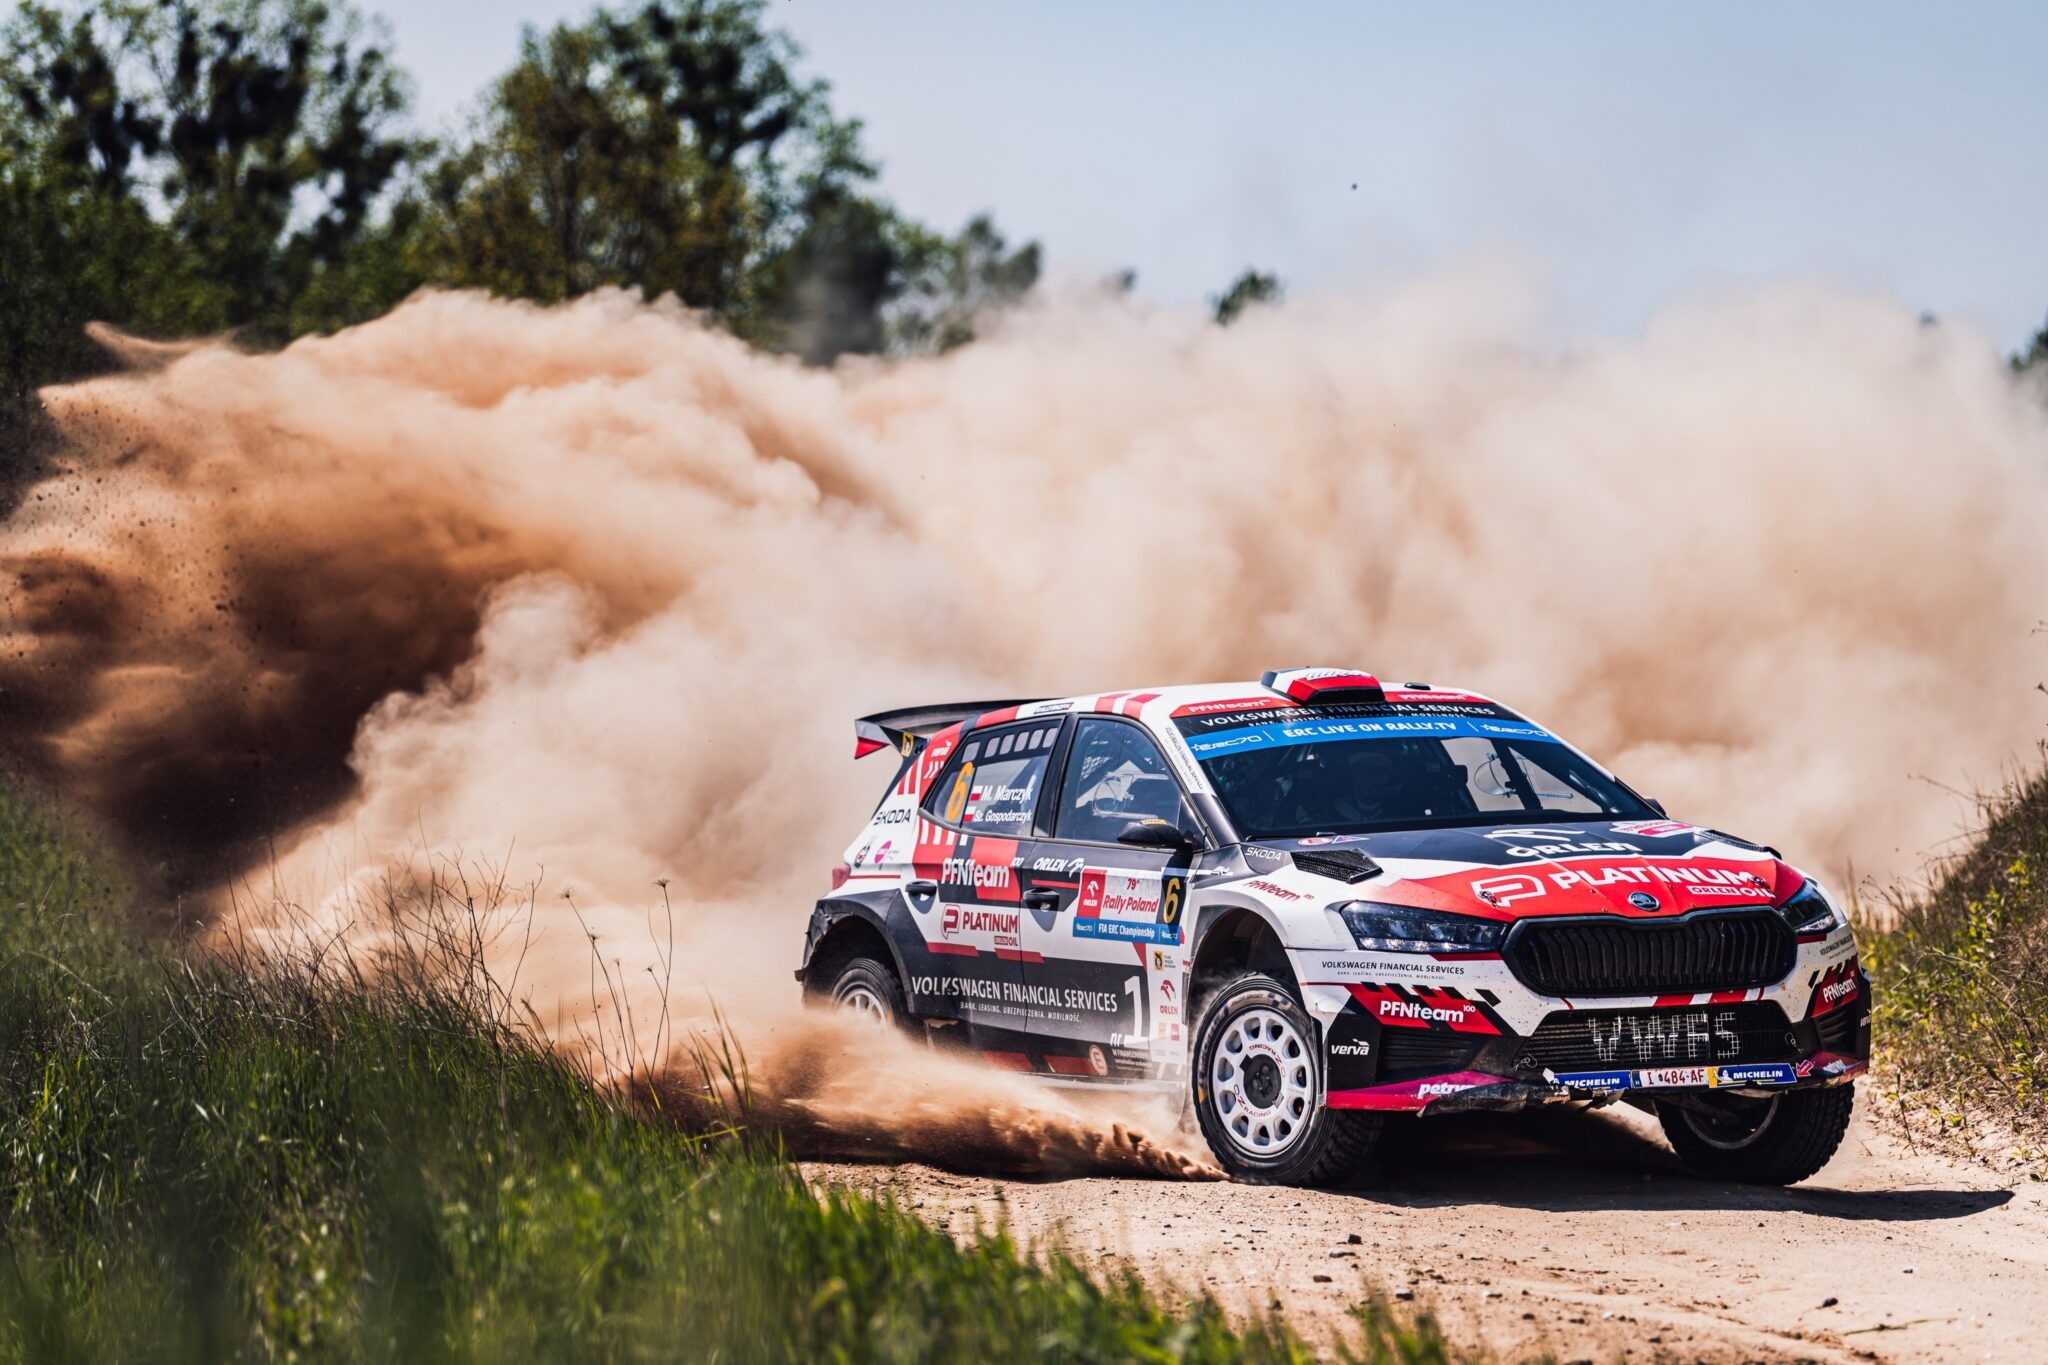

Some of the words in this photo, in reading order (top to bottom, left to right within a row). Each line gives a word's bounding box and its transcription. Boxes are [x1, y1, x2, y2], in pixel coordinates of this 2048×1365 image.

[1188, 701, 1262, 713] PFNteam
[1200, 706, 1323, 727] VOLKSWAGEN
[1326, 702, 1418, 713] FINANCIAL
[1419, 703, 1496, 715] SERVICES
[1282, 726, 1319, 738] ERC
[1317, 724, 1358, 735] LIVE
[1359, 722, 1384, 732] ON
[1384, 721, 1457, 732] RALLY.TV
[946, 762, 974, 822] 6
[980, 785, 993, 801] M.
[995, 784, 1033, 804] Marczyk
[985, 809, 1032, 825] Gospodarczyk
[1507, 842, 1643, 858] ORLEN
[941, 856, 1010, 888] PFNteam
[1033, 857, 1069, 873] ORLEN
[1548, 865, 1753, 889] PLATINUM
[1243, 879, 1301, 902] PFNteam
[1692, 886, 1735, 896] ORLEN
[1740, 887, 1776, 899] OIL
[1102, 894, 1126, 915] Rally
[1126, 896, 1159, 913] Poland
[1163, 877, 1181, 924] 6
[962, 911, 1018, 934] PLATINUM
[1098, 922, 1108, 934] FIA
[1108, 924, 1119, 935] ERC
[1119, 924, 1155, 940] Championship
[1321, 961, 1378, 970] VOLKSWAGEN
[1379, 962, 1425, 972] FINANCIAL
[1426, 963, 1465, 975] SERVICES
[911, 976, 1001, 1000] VOLKSWAGEN
[1003, 982, 1063, 1007] FINANCIAL
[1064, 989, 1118, 1013] SERVICES
[1823, 978, 1857, 1003] PFNteam
[960, 1001, 977, 1010] BANK.
[978, 1003, 1001, 1013] LEASING.
[1160, 1004, 1178, 1015] ORLEN
[1379, 1000, 1464, 1023] PFNteam
[1463, 1005, 1476, 1013] 100
[1110, 1032, 1123, 1047] nr
[1331, 1045, 1370, 1056] verva
[1565, 1077, 1620, 1089] MICHELIN
[1733, 1069, 1784, 1080] MICHELIN
